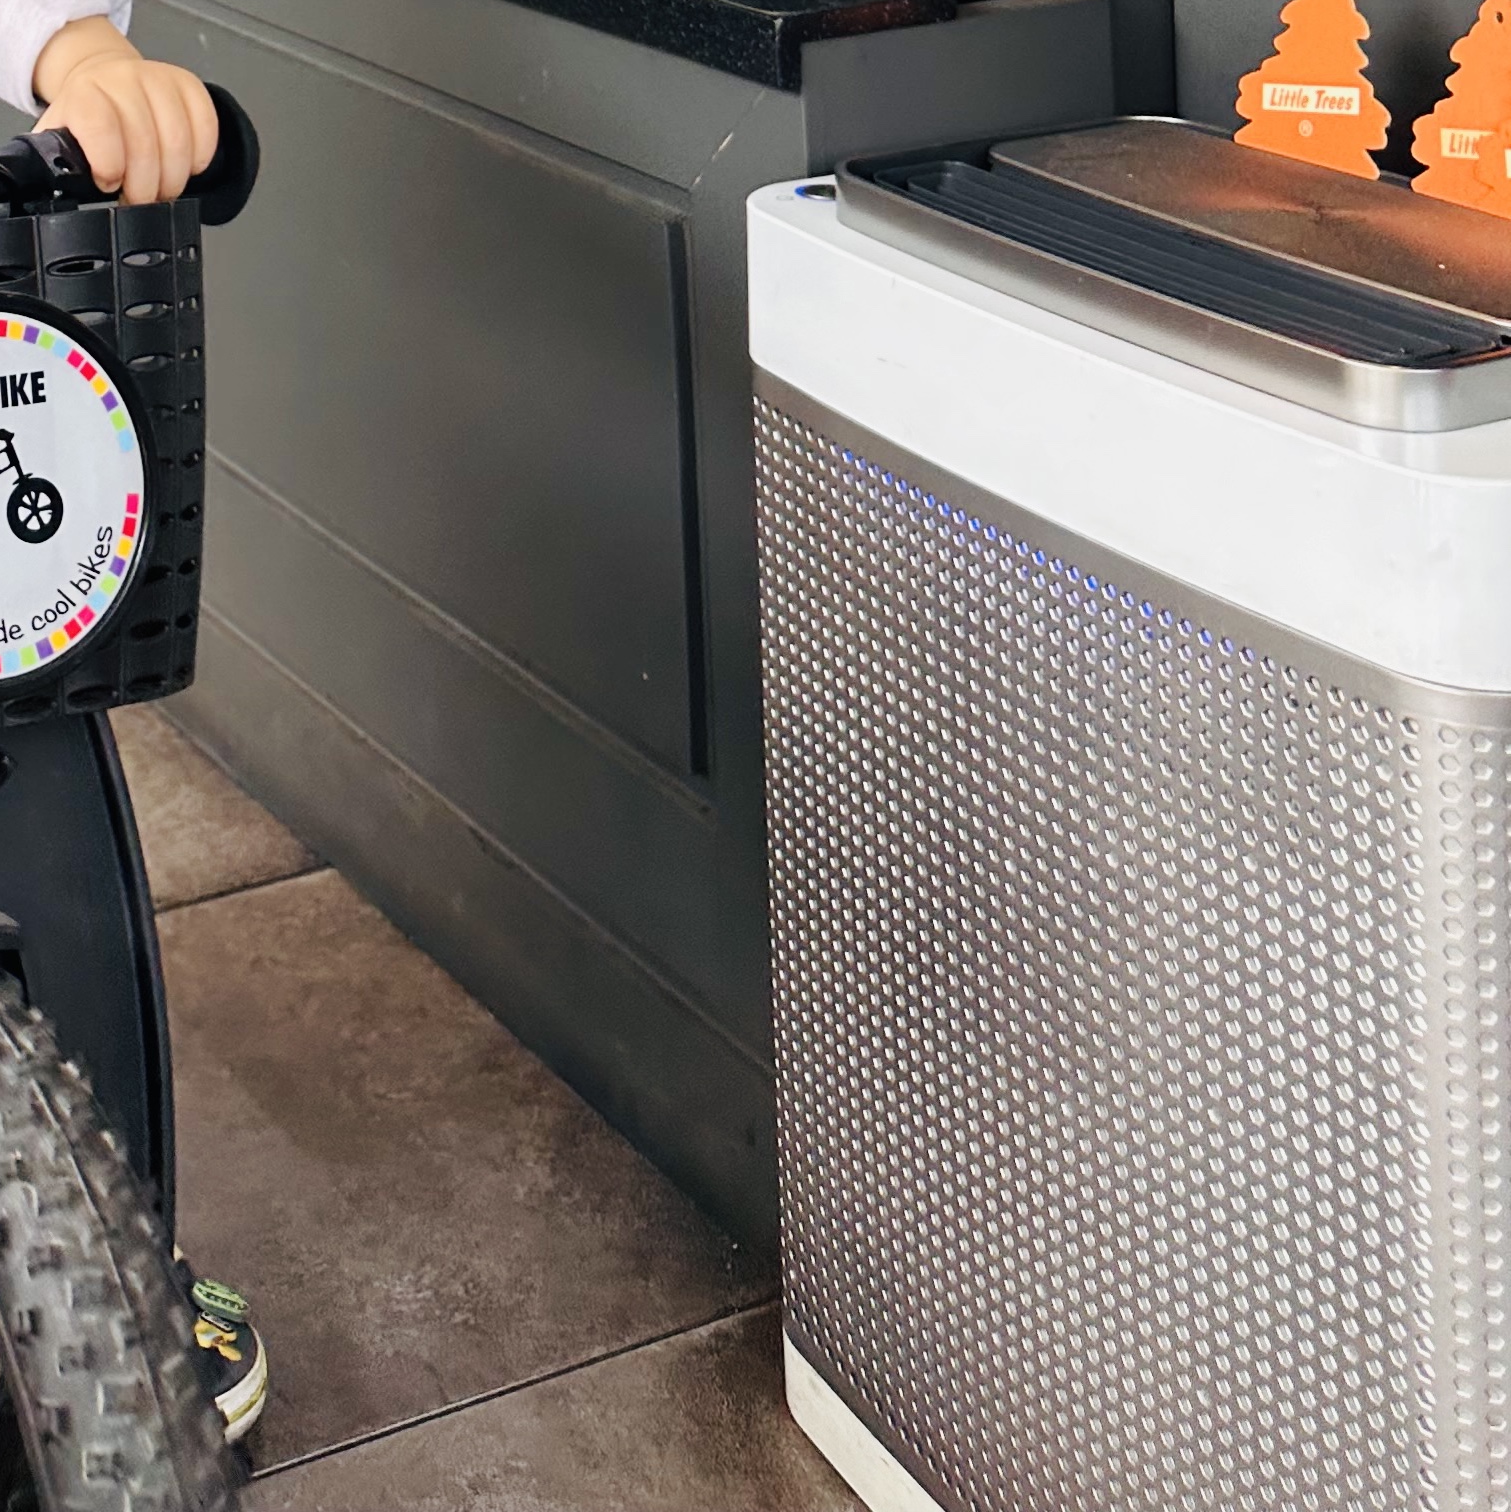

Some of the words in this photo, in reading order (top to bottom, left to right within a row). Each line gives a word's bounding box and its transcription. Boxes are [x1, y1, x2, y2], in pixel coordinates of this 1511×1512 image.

[1269, 88, 1309, 109] Little
[1315, 90, 1354, 111] Trees
[31, 588, 73, 632] cool
[70, 525, 114, 596] bikes
